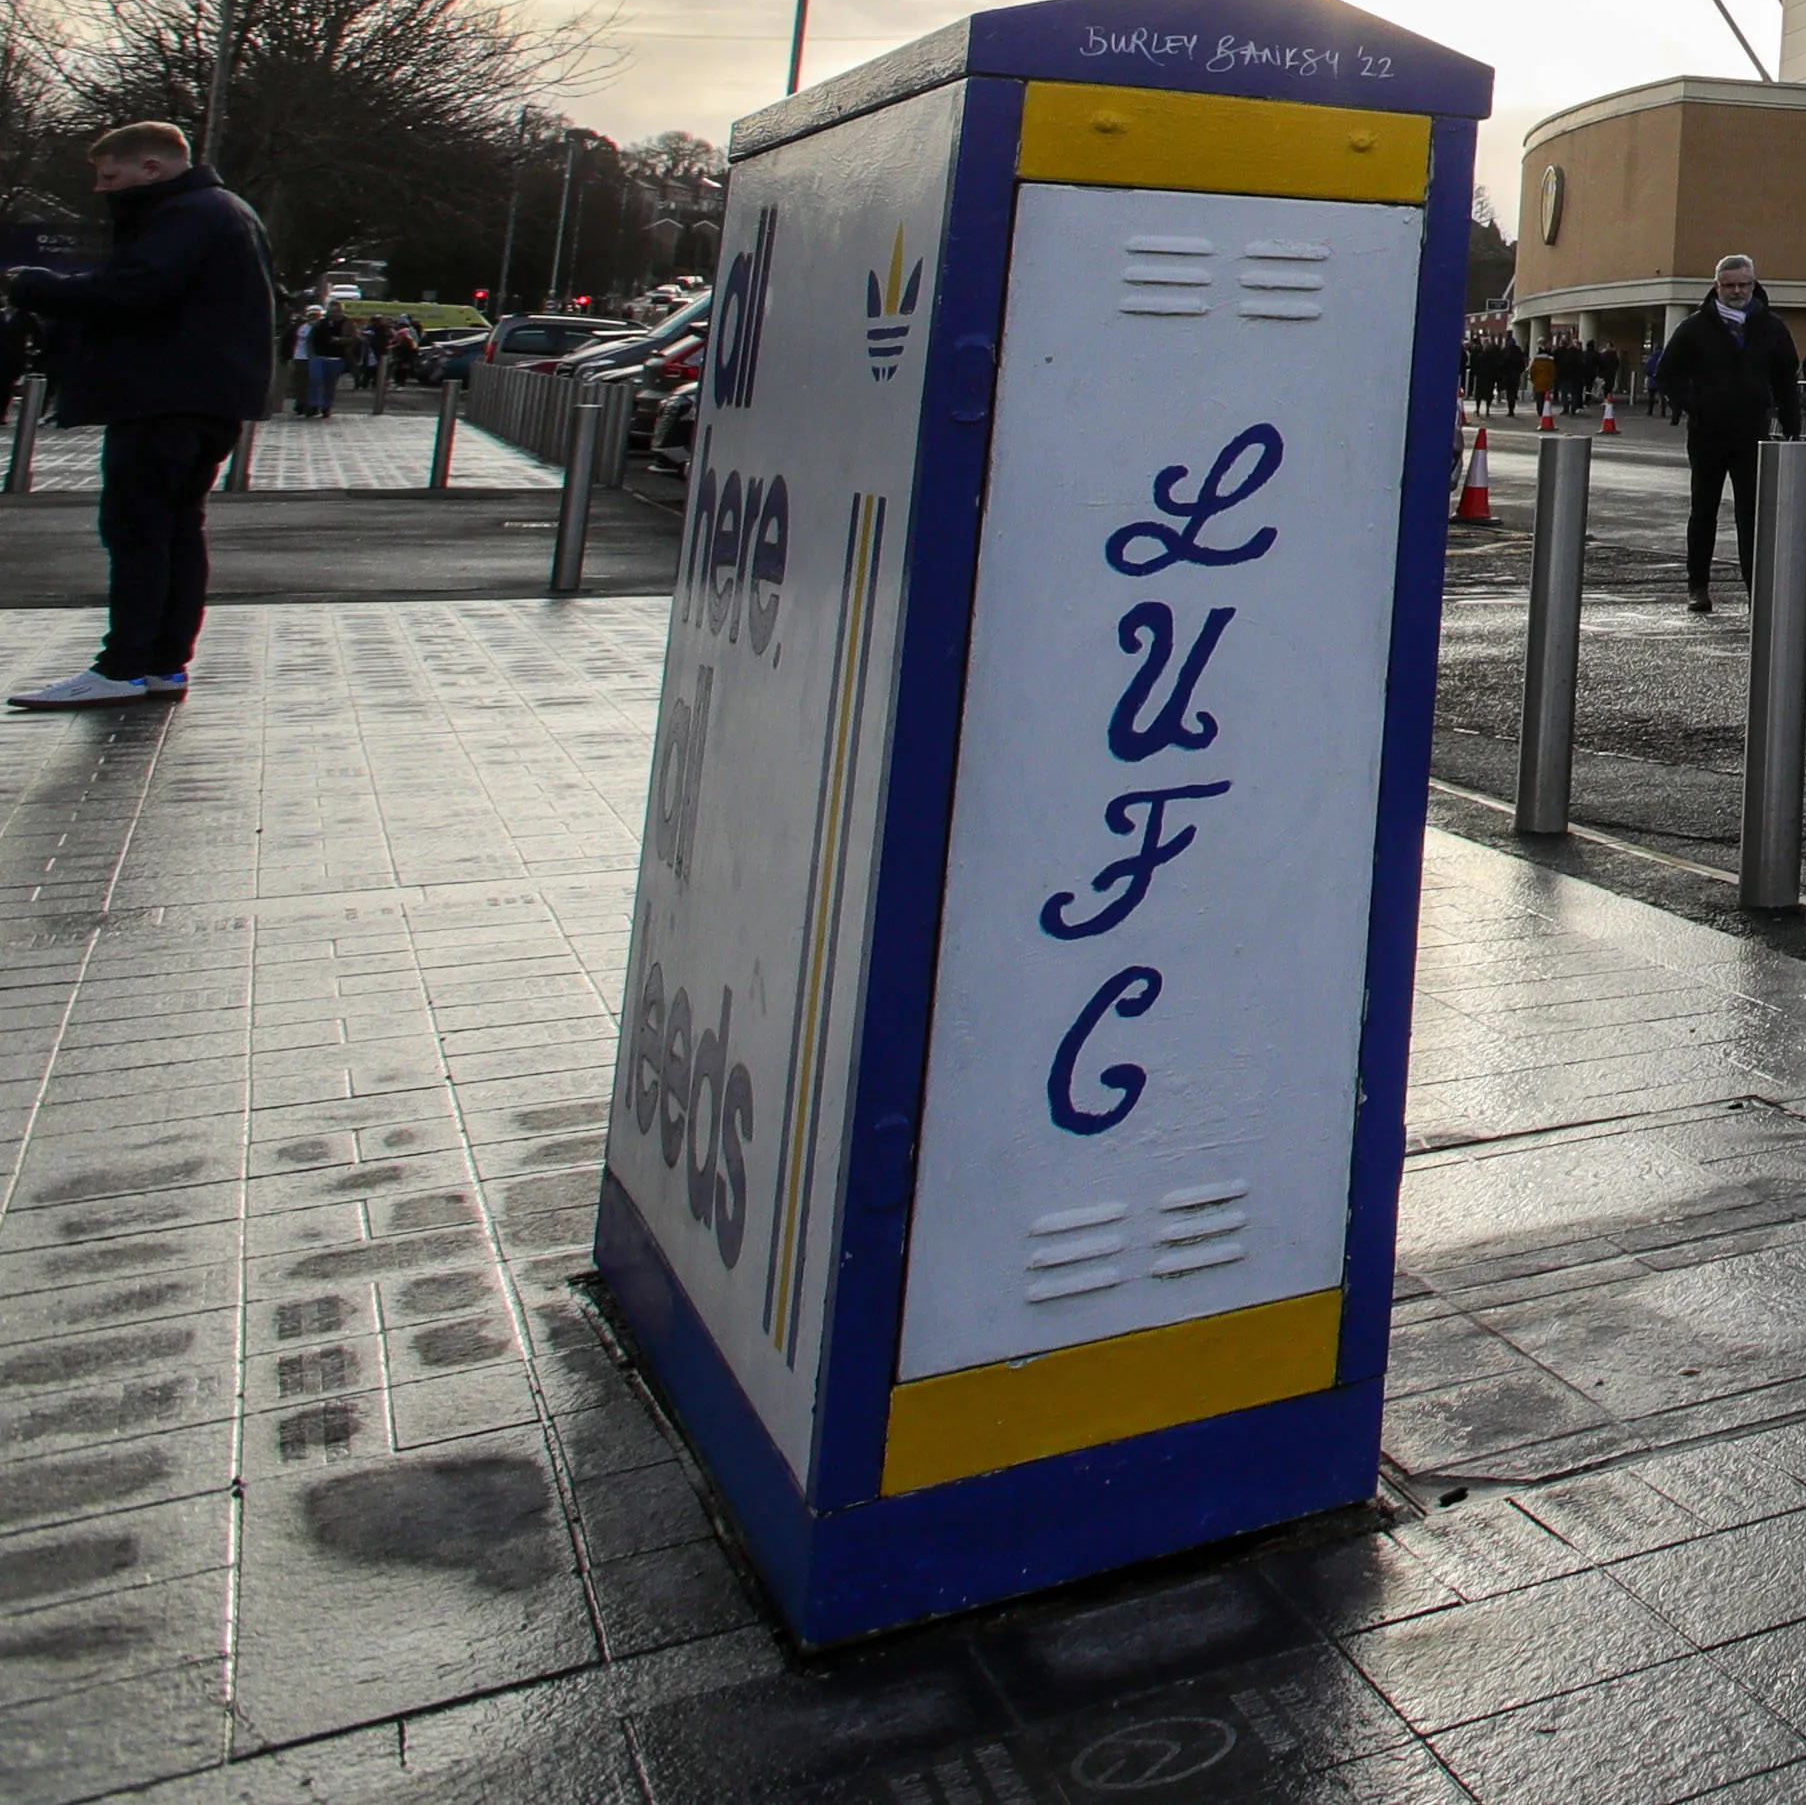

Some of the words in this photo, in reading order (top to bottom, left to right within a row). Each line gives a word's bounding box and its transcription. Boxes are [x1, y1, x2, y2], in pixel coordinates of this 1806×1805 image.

[1080, 25, 1199, 66] BURLEY
[1357, 45, 1395, 78] '22
[713, 206, 778, 411] all
